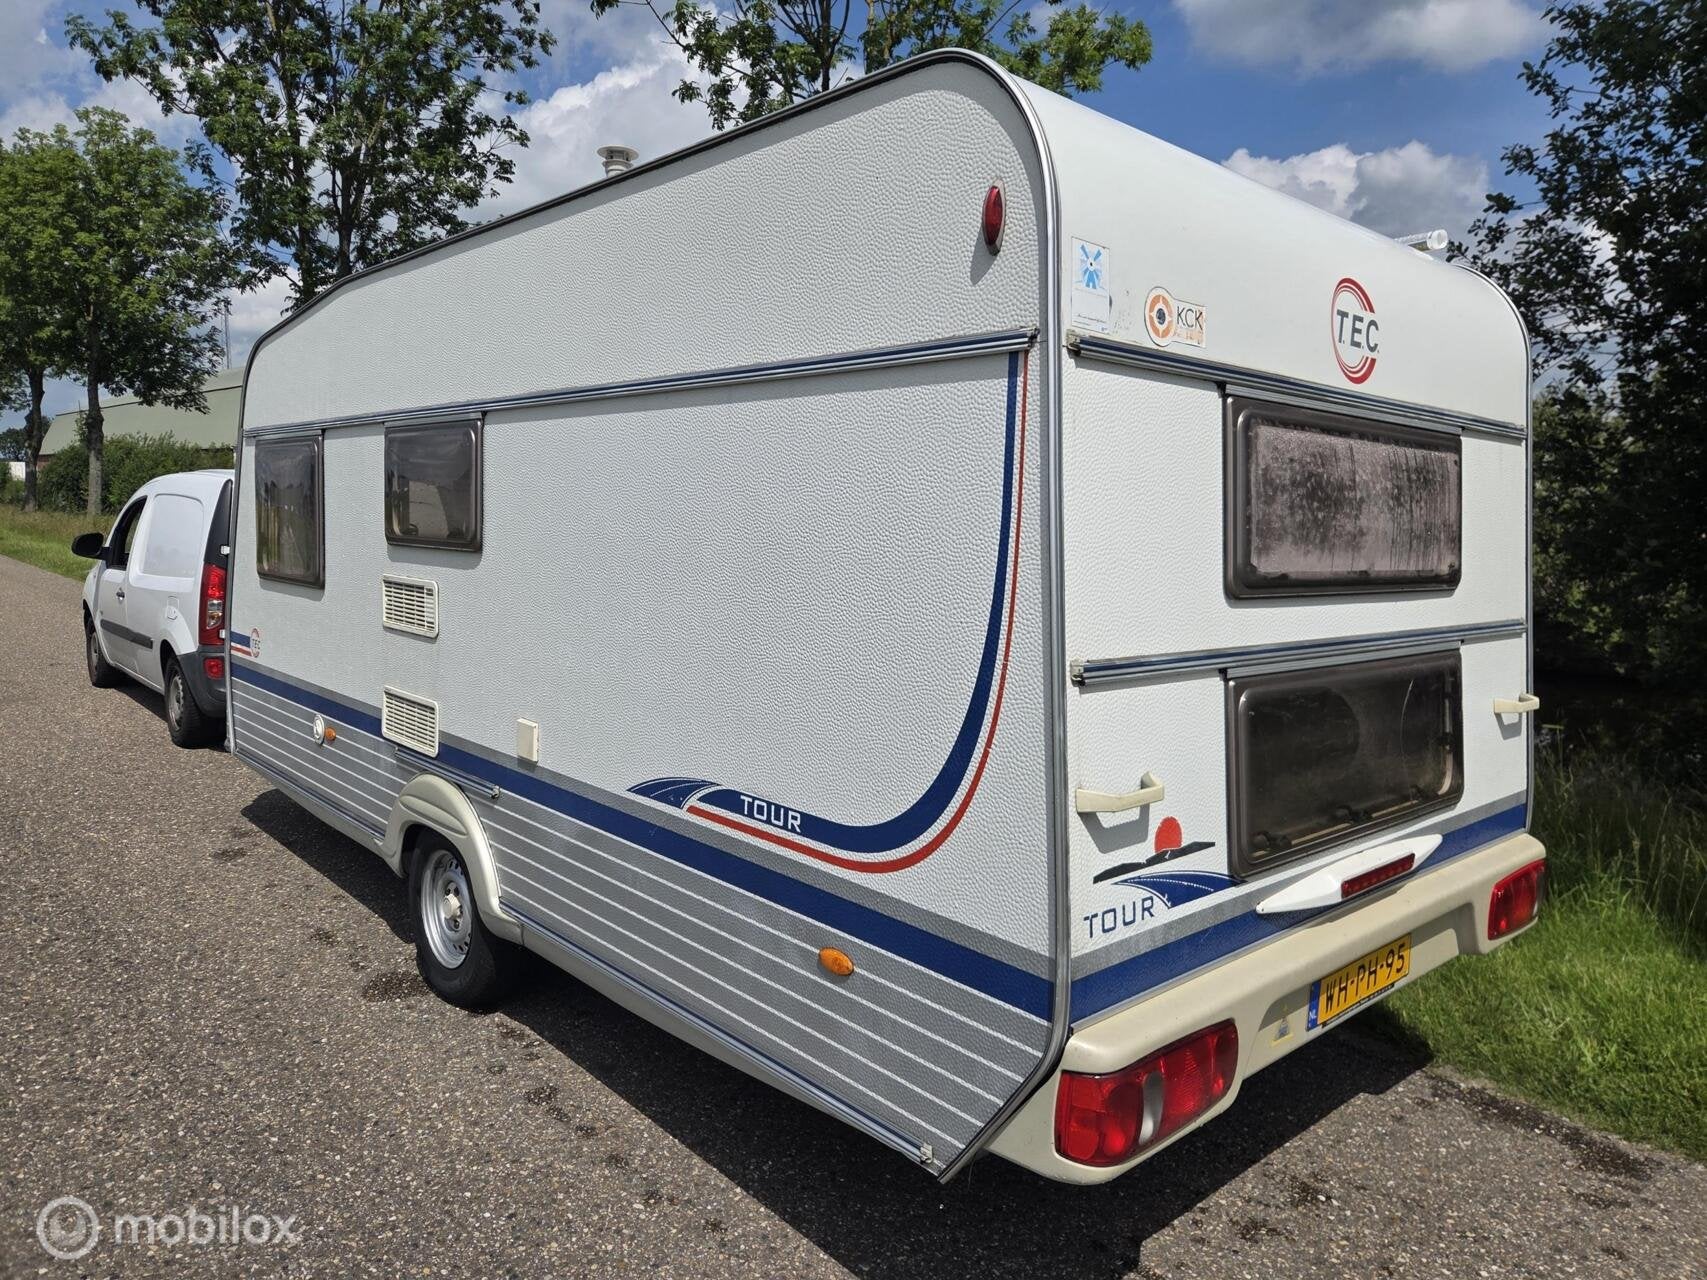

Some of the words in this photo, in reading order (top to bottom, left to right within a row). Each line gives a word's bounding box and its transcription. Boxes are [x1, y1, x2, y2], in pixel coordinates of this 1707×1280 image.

[1176, 306, 1204, 331] KCK
[739, 794, 802, 833] TOUR
[1083, 895, 1156, 939] TOUR
[1324, 943, 1406, 1015] WH-PH-95
